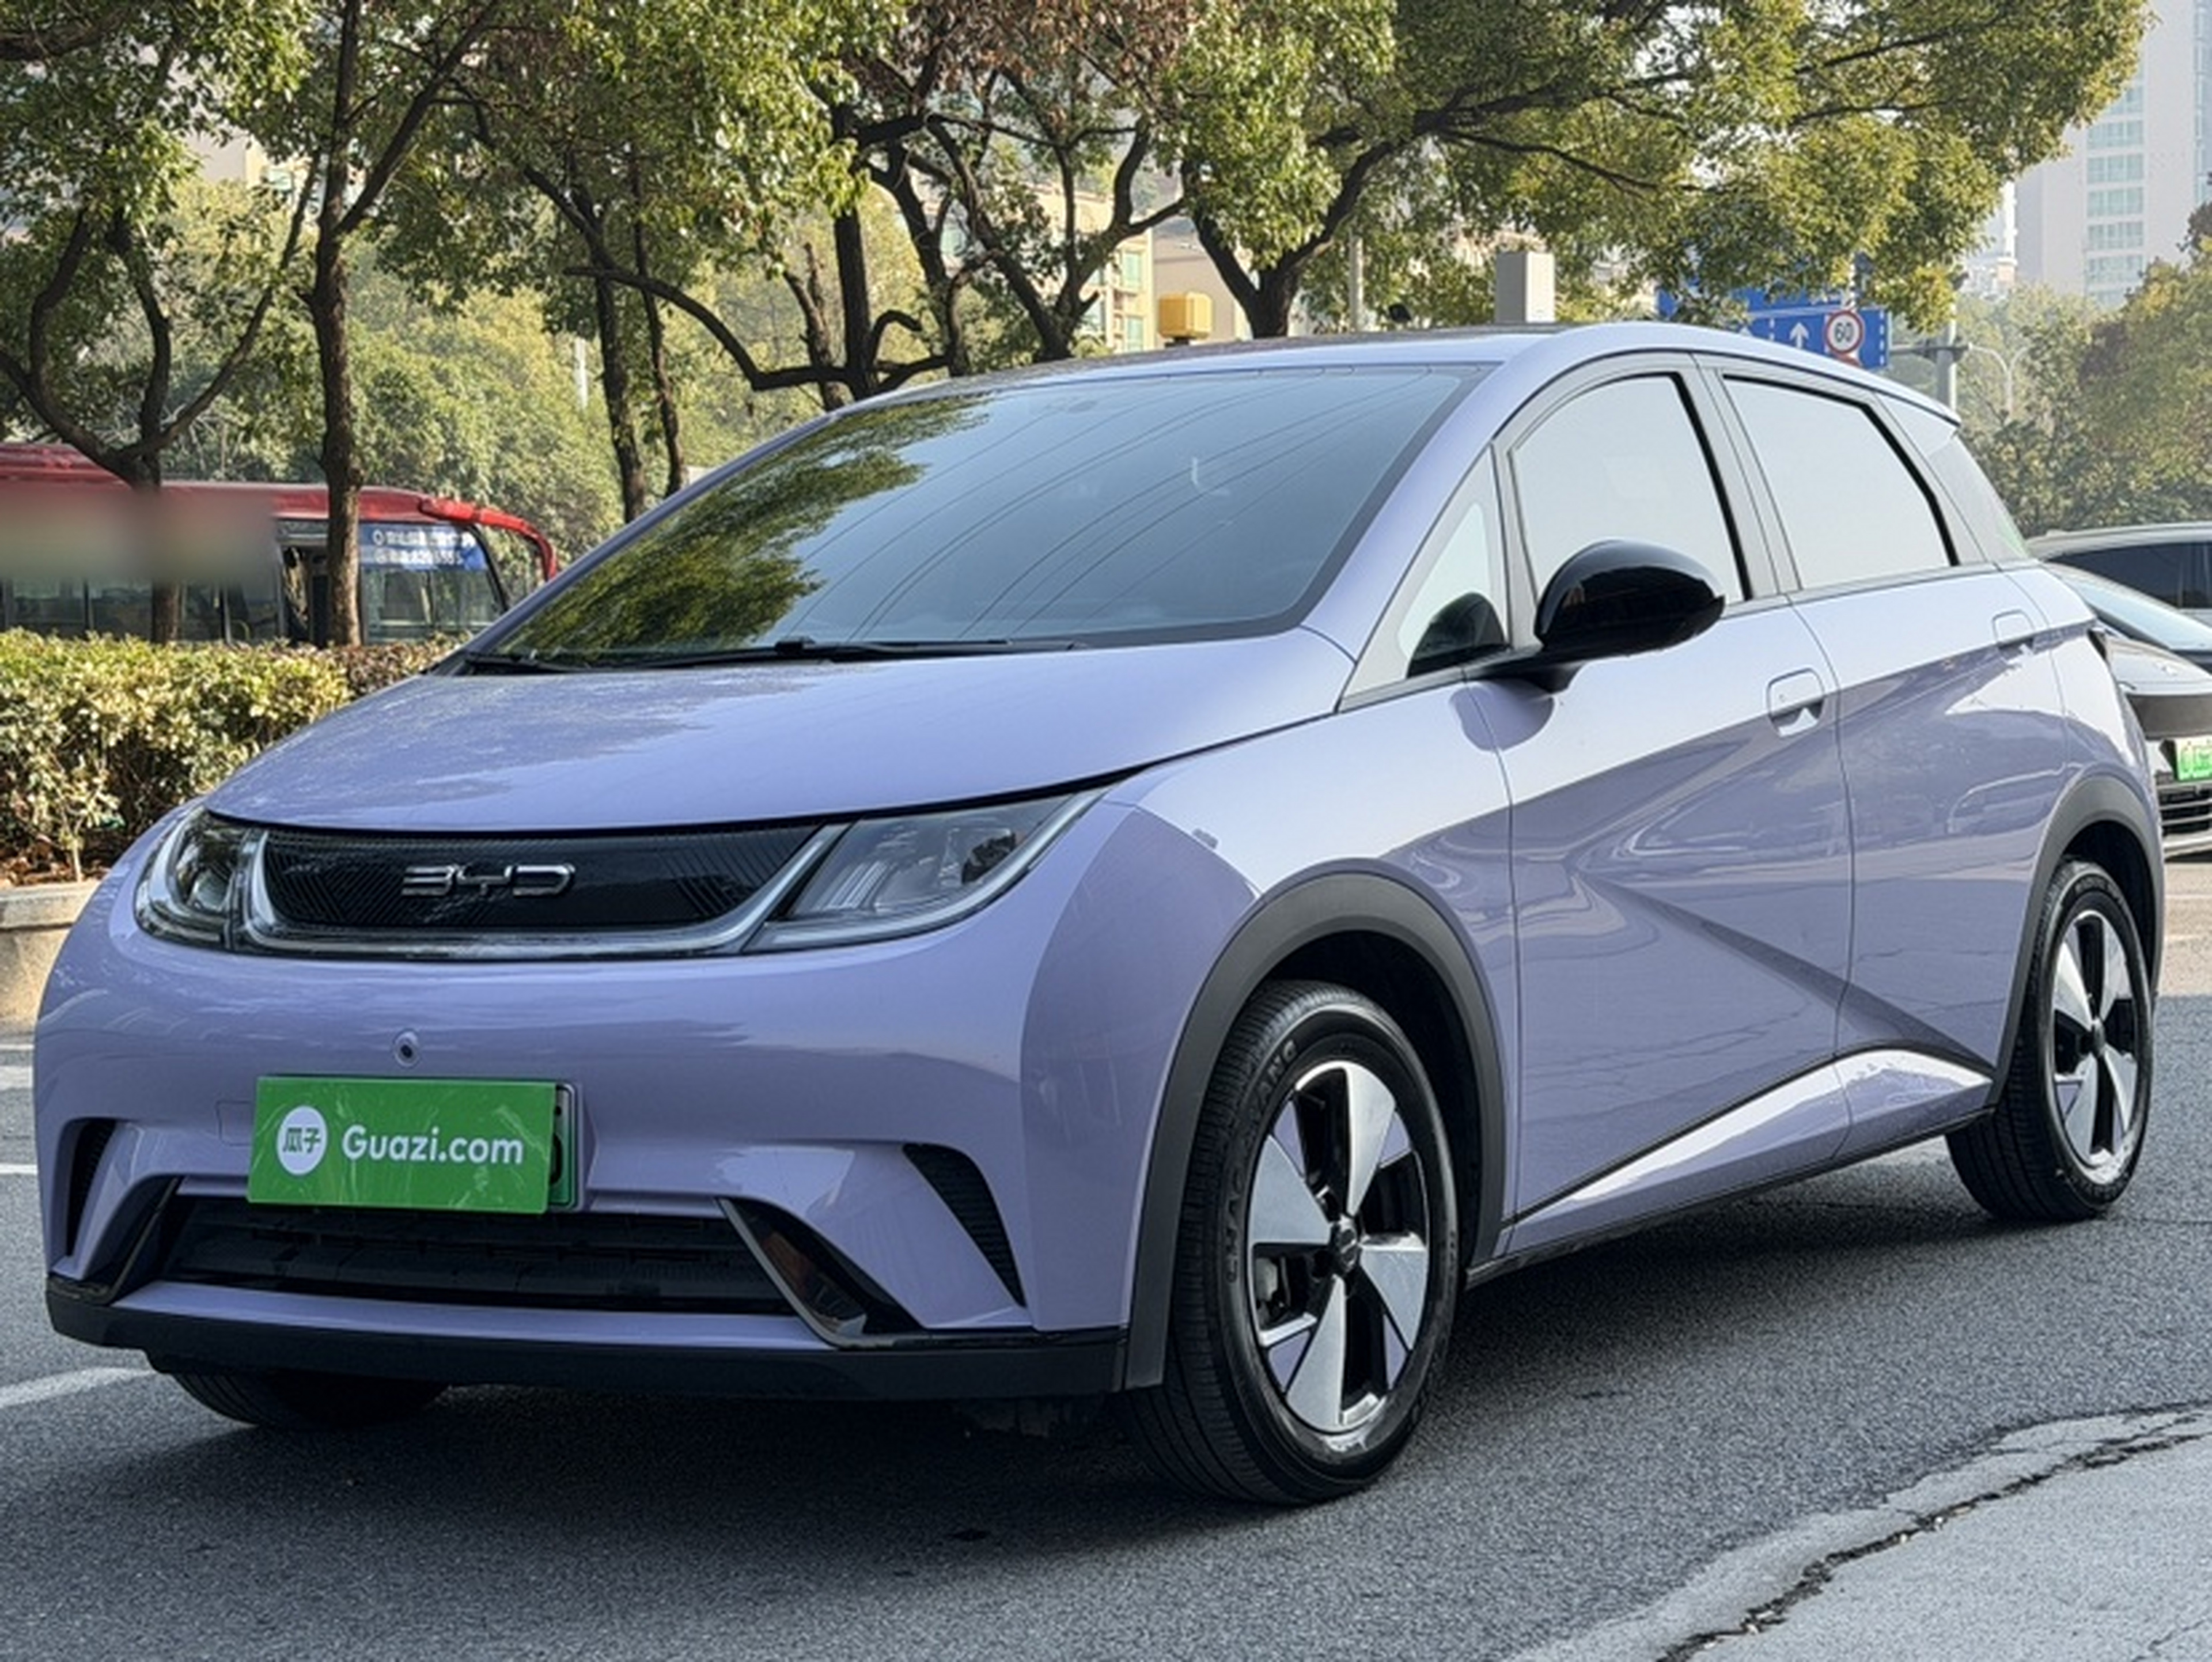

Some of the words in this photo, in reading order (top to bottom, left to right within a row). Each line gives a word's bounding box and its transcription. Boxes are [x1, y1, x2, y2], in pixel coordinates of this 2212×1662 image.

[1834, 322, 1854, 343] 60
[402, 864, 575, 896] BYD
[283, 1127, 320, 1152] 瓜子
[342, 1124, 524, 1164] Guazi.com
[1226, 1039, 1297, 1284] CHAOANG
